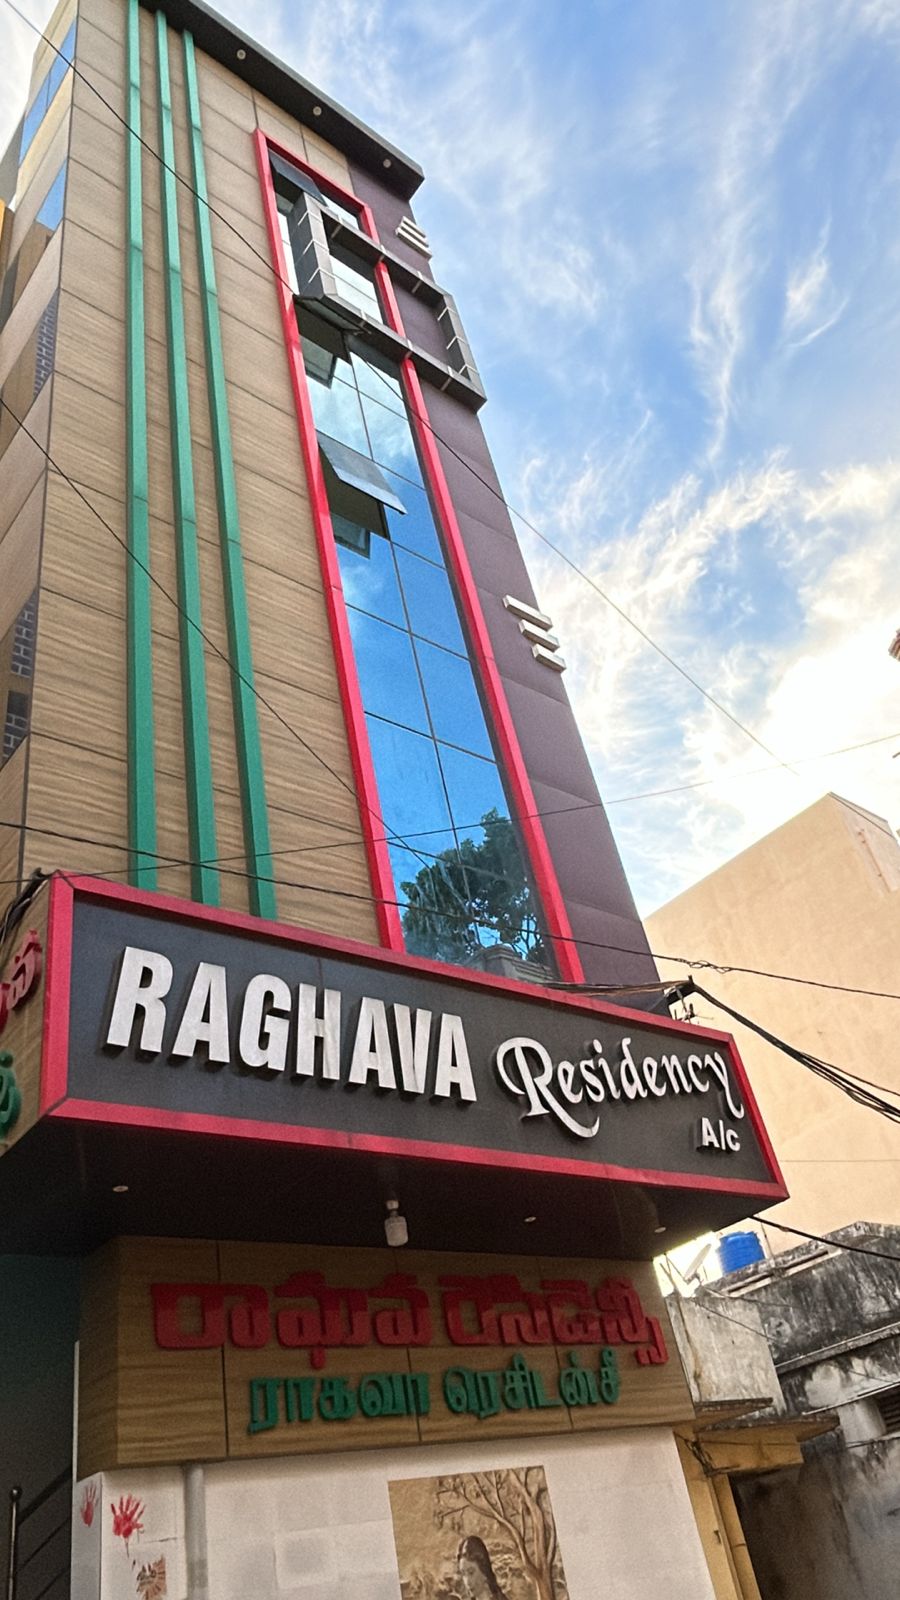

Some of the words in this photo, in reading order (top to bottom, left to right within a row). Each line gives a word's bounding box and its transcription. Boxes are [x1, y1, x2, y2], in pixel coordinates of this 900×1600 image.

[107, 946, 477, 1102] RAGHAVA
[496, 1036, 745, 1138] Residency
[151, 1270, 433, 1369] రాఘవ
[248, 1371, 431, 1435] ராகவா
